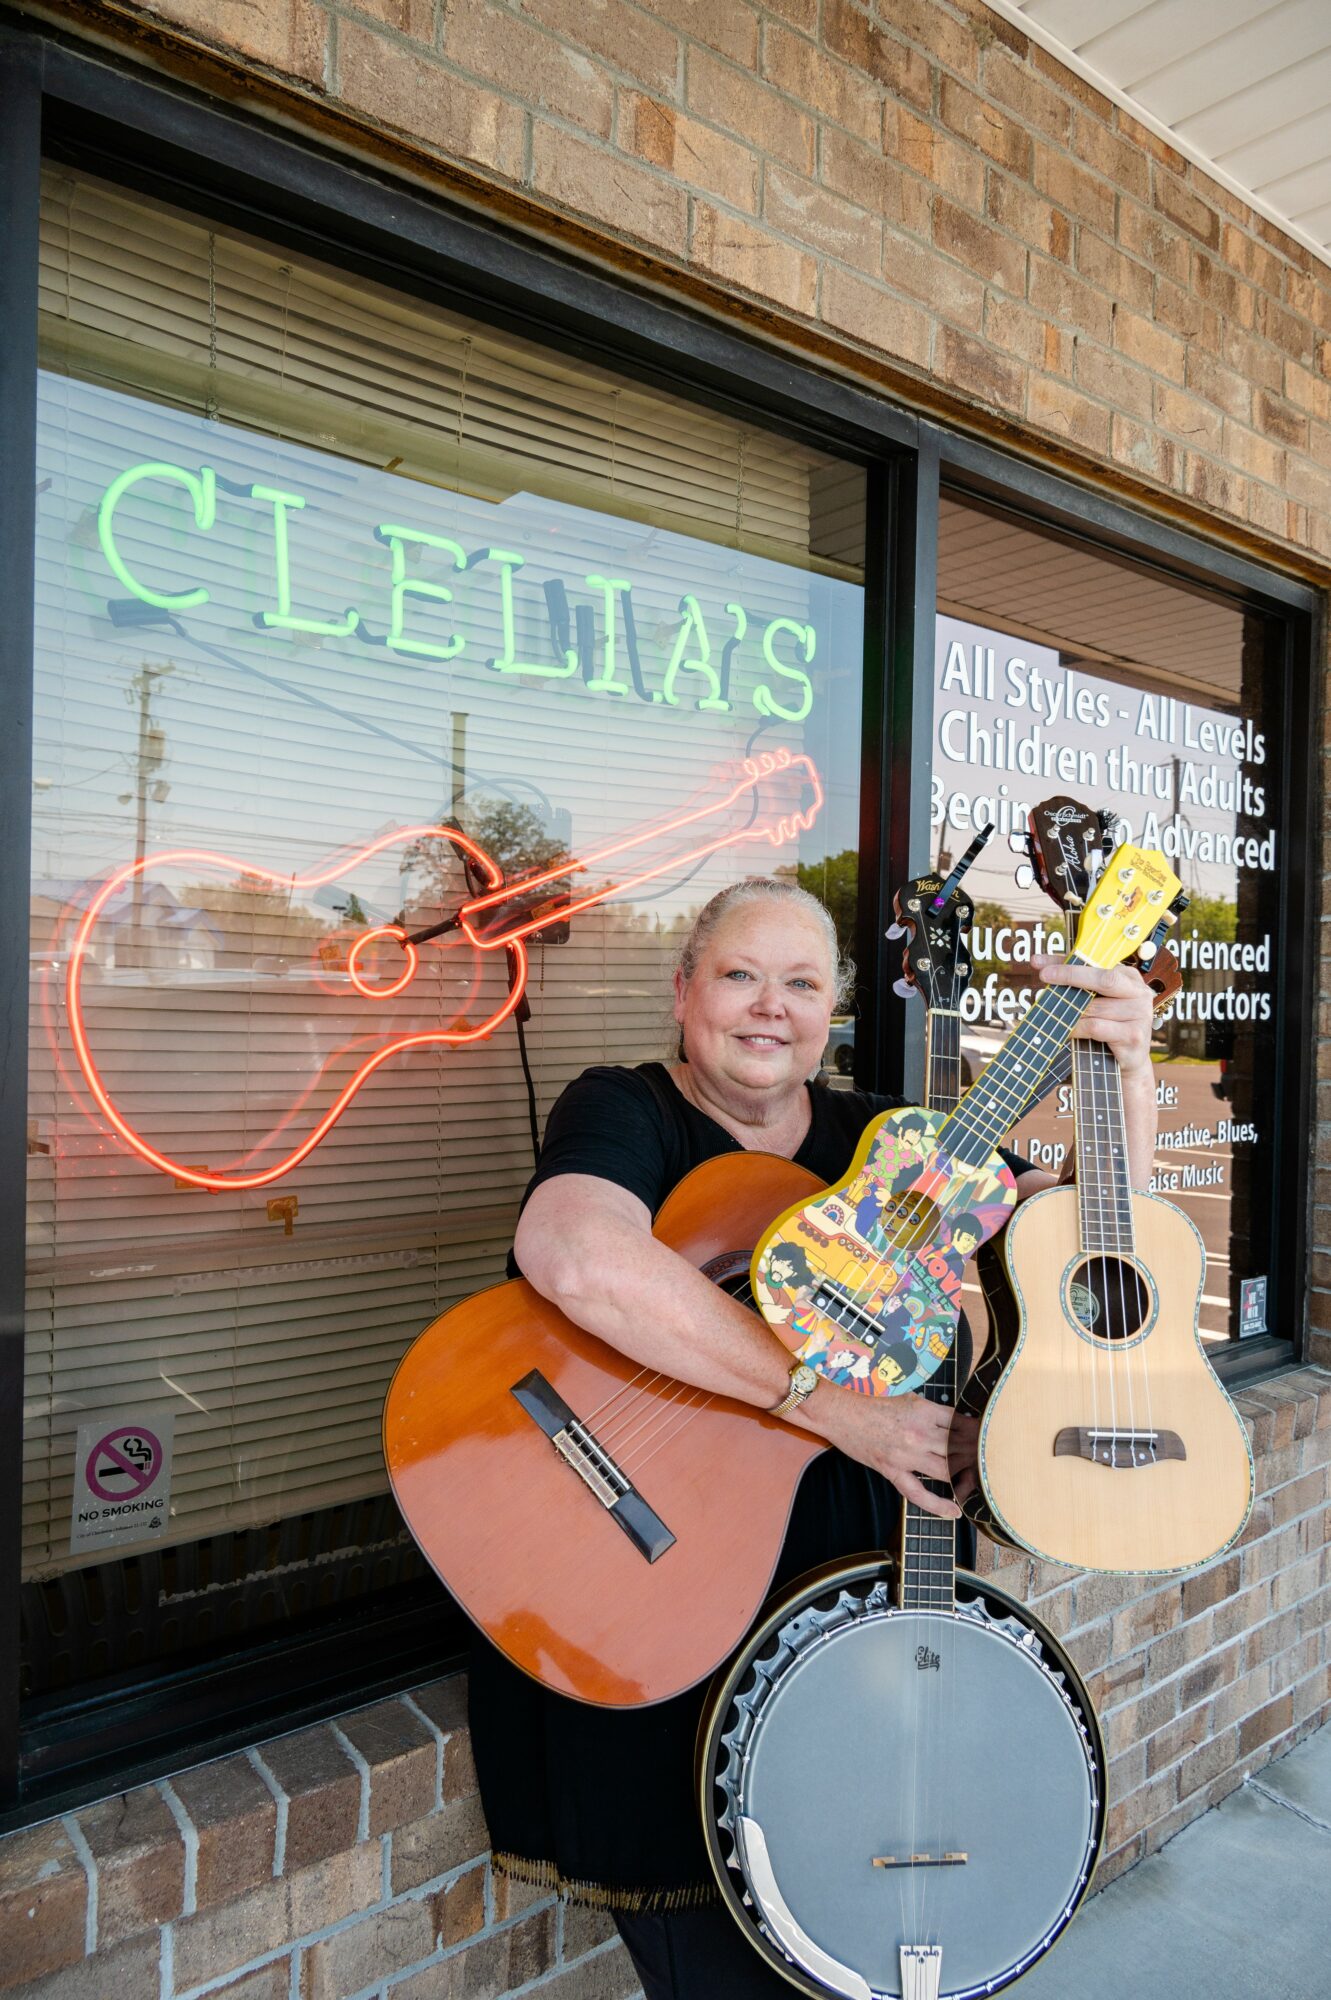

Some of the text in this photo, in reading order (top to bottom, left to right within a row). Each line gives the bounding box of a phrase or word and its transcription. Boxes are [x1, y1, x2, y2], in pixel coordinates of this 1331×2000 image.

[98, 462, 817, 722] CLELIA'S
[942, 641, 994, 700] All
[1006, 657, 1110, 727] Styles
[1137, 693, 1176, 743] All
[1184, 705, 1265, 764] Levels
[940, 709, 1265, 817] Children thru Adults
[931, 774, 1031, 847] Begin
[1141, 811, 1275, 871] Advanced
[1165, 929, 1270, 972] erienced
[1218, 1119, 1258, 1144] Blues,
[1148, 1160, 1224, 1193] aise Music
[78, 1499, 164, 1522] NO SMOKING
